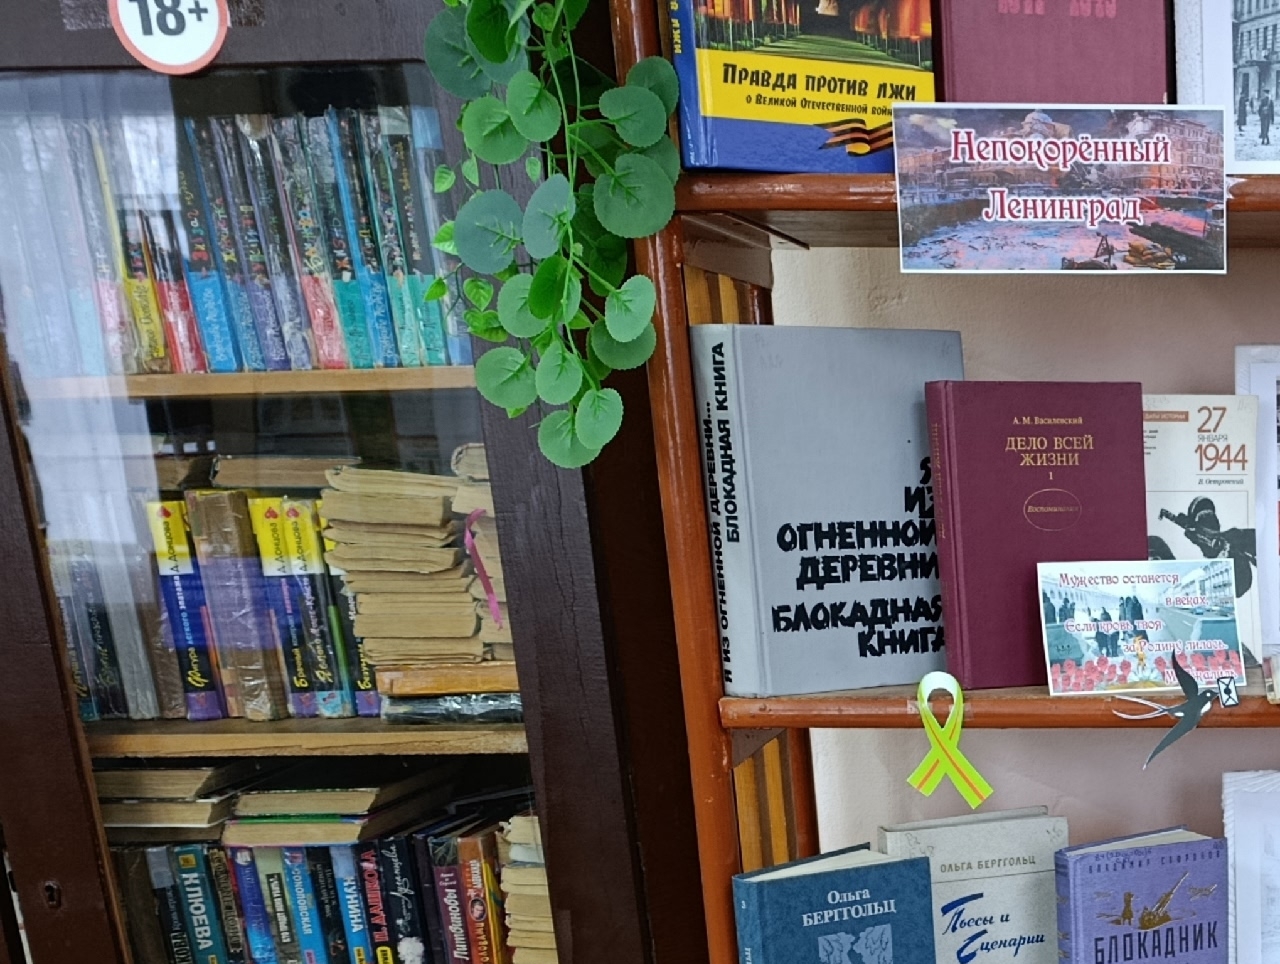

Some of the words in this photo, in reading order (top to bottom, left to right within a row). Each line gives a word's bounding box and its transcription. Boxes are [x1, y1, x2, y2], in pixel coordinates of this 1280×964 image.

[951, 130, 1171, 168] Непокорённый
[983, 190, 1143, 227] Ленинград
[711, 341, 729, 412] КНИГА
[1197, 406, 1227, 433] 27
[1005, 437, 1048, 452] ДЕЛО
[1053, 433, 1094, 450] ВСЕЙ
[1194, 443, 1248, 472] 1944
[1019, 452, 1080, 467] ЖИЗНИ
[716, 419, 740, 543] БЛОКАДНАЯ
[710, 519, 730, 632] ОГНЕННОЙ
[1059, 573, 1119, 589] Мужество
[1122, 573, 1180, 584] останется
[1099, 620, 1133, 633] кровь
[1136, 619, 1162, 631] твоя
[939, 861, 973, 874] ОЛЬГА
[976, 854, 1037, 871] БЕРГГОЛЬЦ
[827, 886, 871, 905] Ольга
[182, 873, 213, 950] КЛЮЕВА
[802, 898, 897, 928] БЕРГГОЛЬЦ
[940, 892, 995, 937] Пьесы
[999, 912, 1012, 925] и
[955, 929, 1046, 964] Сценарии
